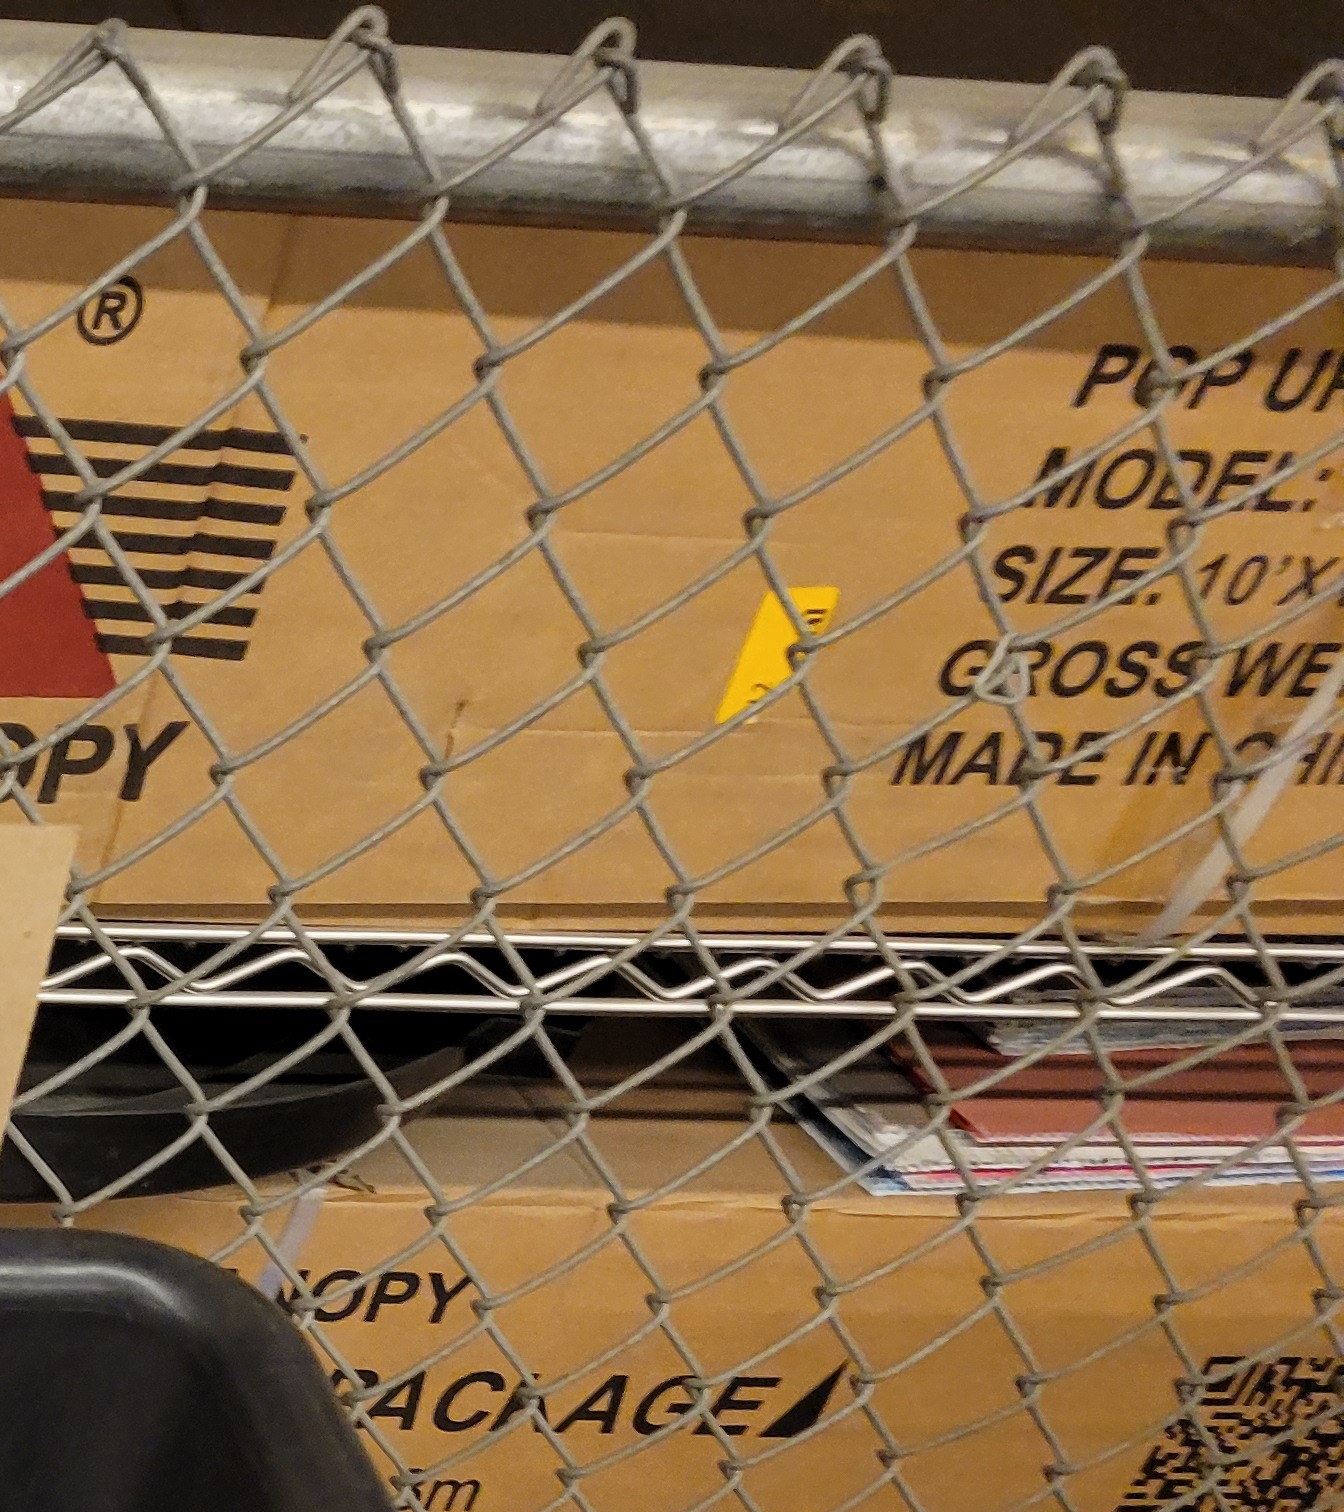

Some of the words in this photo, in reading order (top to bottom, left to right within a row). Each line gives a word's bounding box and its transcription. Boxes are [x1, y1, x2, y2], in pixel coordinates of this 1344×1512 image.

[1074, 342, 1253, 411] POP
[1224, 641, 1344, 698] WE
[889, 731, 1112, 787] MADE
[1123, 731, 1213, 787] IN
